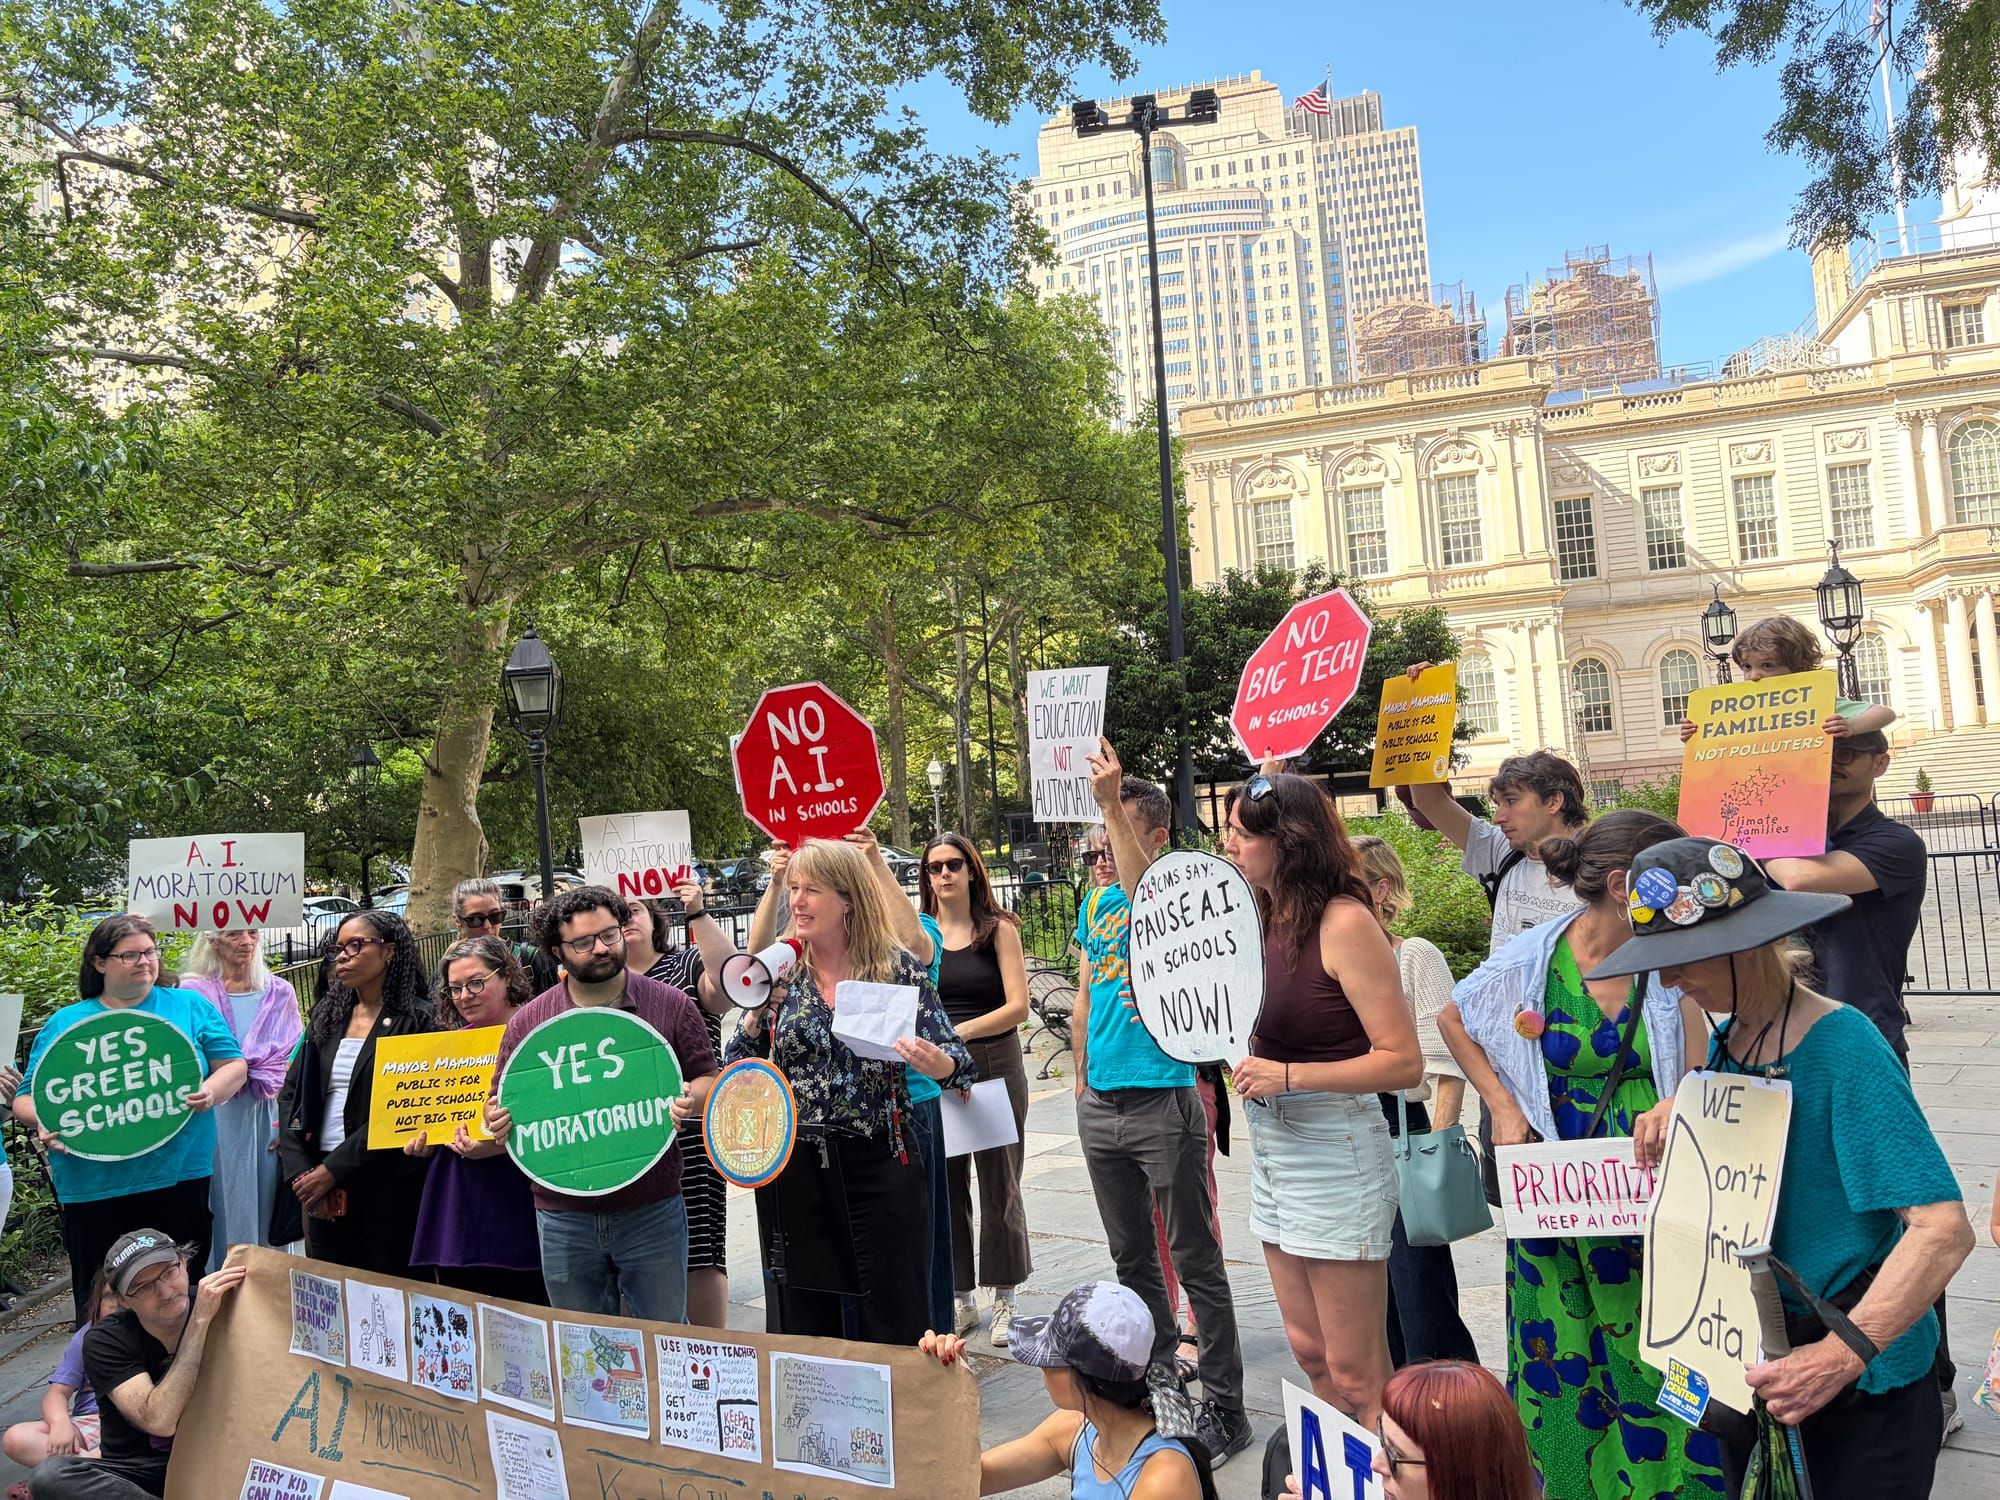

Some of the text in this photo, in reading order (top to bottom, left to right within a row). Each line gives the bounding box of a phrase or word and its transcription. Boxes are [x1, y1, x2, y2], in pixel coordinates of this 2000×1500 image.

[1284, 610, 1330, 654] NO
[1245, 639, 1359, 703] BIG TECH
[1040, 674, 1091, 698] WE WANT
[1384, 703, 1408, 714] MAYOR
[1710, 686, 1812, 716] PROTECT
[767, 700, 825, 750] NO
[1035, 700, 1101, 739] EDUCATION
[1249, 698, 1329, 731] IN SCHOOLS
[1388, 718, 1410, 731] PUBLIC
[1421, 714, 1435, 725] FOR
[1702, 709, 1816, 739] FAMILIES!
[1382, 732, 1439, 749] PUBLIC SCHOOLS,
[1694, 736, 1825, 762] NOT POLLUTERS
[1054, 746, 1072, 772] NOT
[1385, 751, 1431, 765] NOT BIG TECH
[769, 797, 858, 823] IN SCHOOLS
[1729, 814, 1778, 828] climate
[1736, 824, 1789, 835] families
[1732, 836, 1751, 850] nyc
[587, 842, 691, 876] MORATORIUM
[133, 871, 297, 901] MORATORIUM
[174, 899, 273, 929] NOW
[1134, 879, 1241, 951] PAUSE A.I.
[1141, 959, 1155, 982] IN
[1164, 929, 1237, 973] SCHOOLS
[1160, 982, 1235, 1044] NOW!
[75, 1026, 147, 1065] YES
[382, 1061, 429, 1075] MAYOR
[538, 1036, 625, 1090] YES
[44, 1055, 172, 1104] GREEN
[396, 1079, 440, 1091] PUBLIC
[460, 1075, 480, 1085] FOR
[58, 1084, 194, 1138] SCHOOLS
[387, 1091, 485, 1109] PUBLIC SCHOOLS,
[1702, 1080, 1744, 1123] WE
[396, 1110, 476, 1126] NOT BIG TECH
[516, 1094, 678, 1158] MORATORIUM
[1537, 1214, 1579, 1230] KEEP
[1587, 1214, 1604, 1228] AI
[1612, 1213, 1637, 1228] OUT
[295, 1274, 339, 1301] LET KIDS USE
[296, 1289, 337, 1318] THEIR OWN
[296, 1305, 330, 1333] BRAINS!
[661, 1339, 755, 1359] USE ROBOT TEACHERS
[1670, 1371, 1688, 1390] DATA
[1671, 1361, 1689, 1377] STOP
[666, 1395, 685, 1407] GET
[1666, 1381, 1700, 1406] CENTERS
[271, 1368, 354, 1462] AI
[666, 1410, 697, 1422] ROBOT
[724, 1409, 754, 1431] KEEP AI
[362, 1400, 478, 1478] MORATORIUM
[666, 1426, 688, 1439] KIDS
[724, 1426, 737, 1436] OUT
[743, 1431, 754, 1440] OUR
[851, 1426, 883, 1448] KEEP AI
[851, 1442, 865, 1451] OUT
[871, 1446, 884, 1456] OUR
[250, 1465, 308, 1493] EVERY KID
[247, 1486, 270, 1500] CAN
